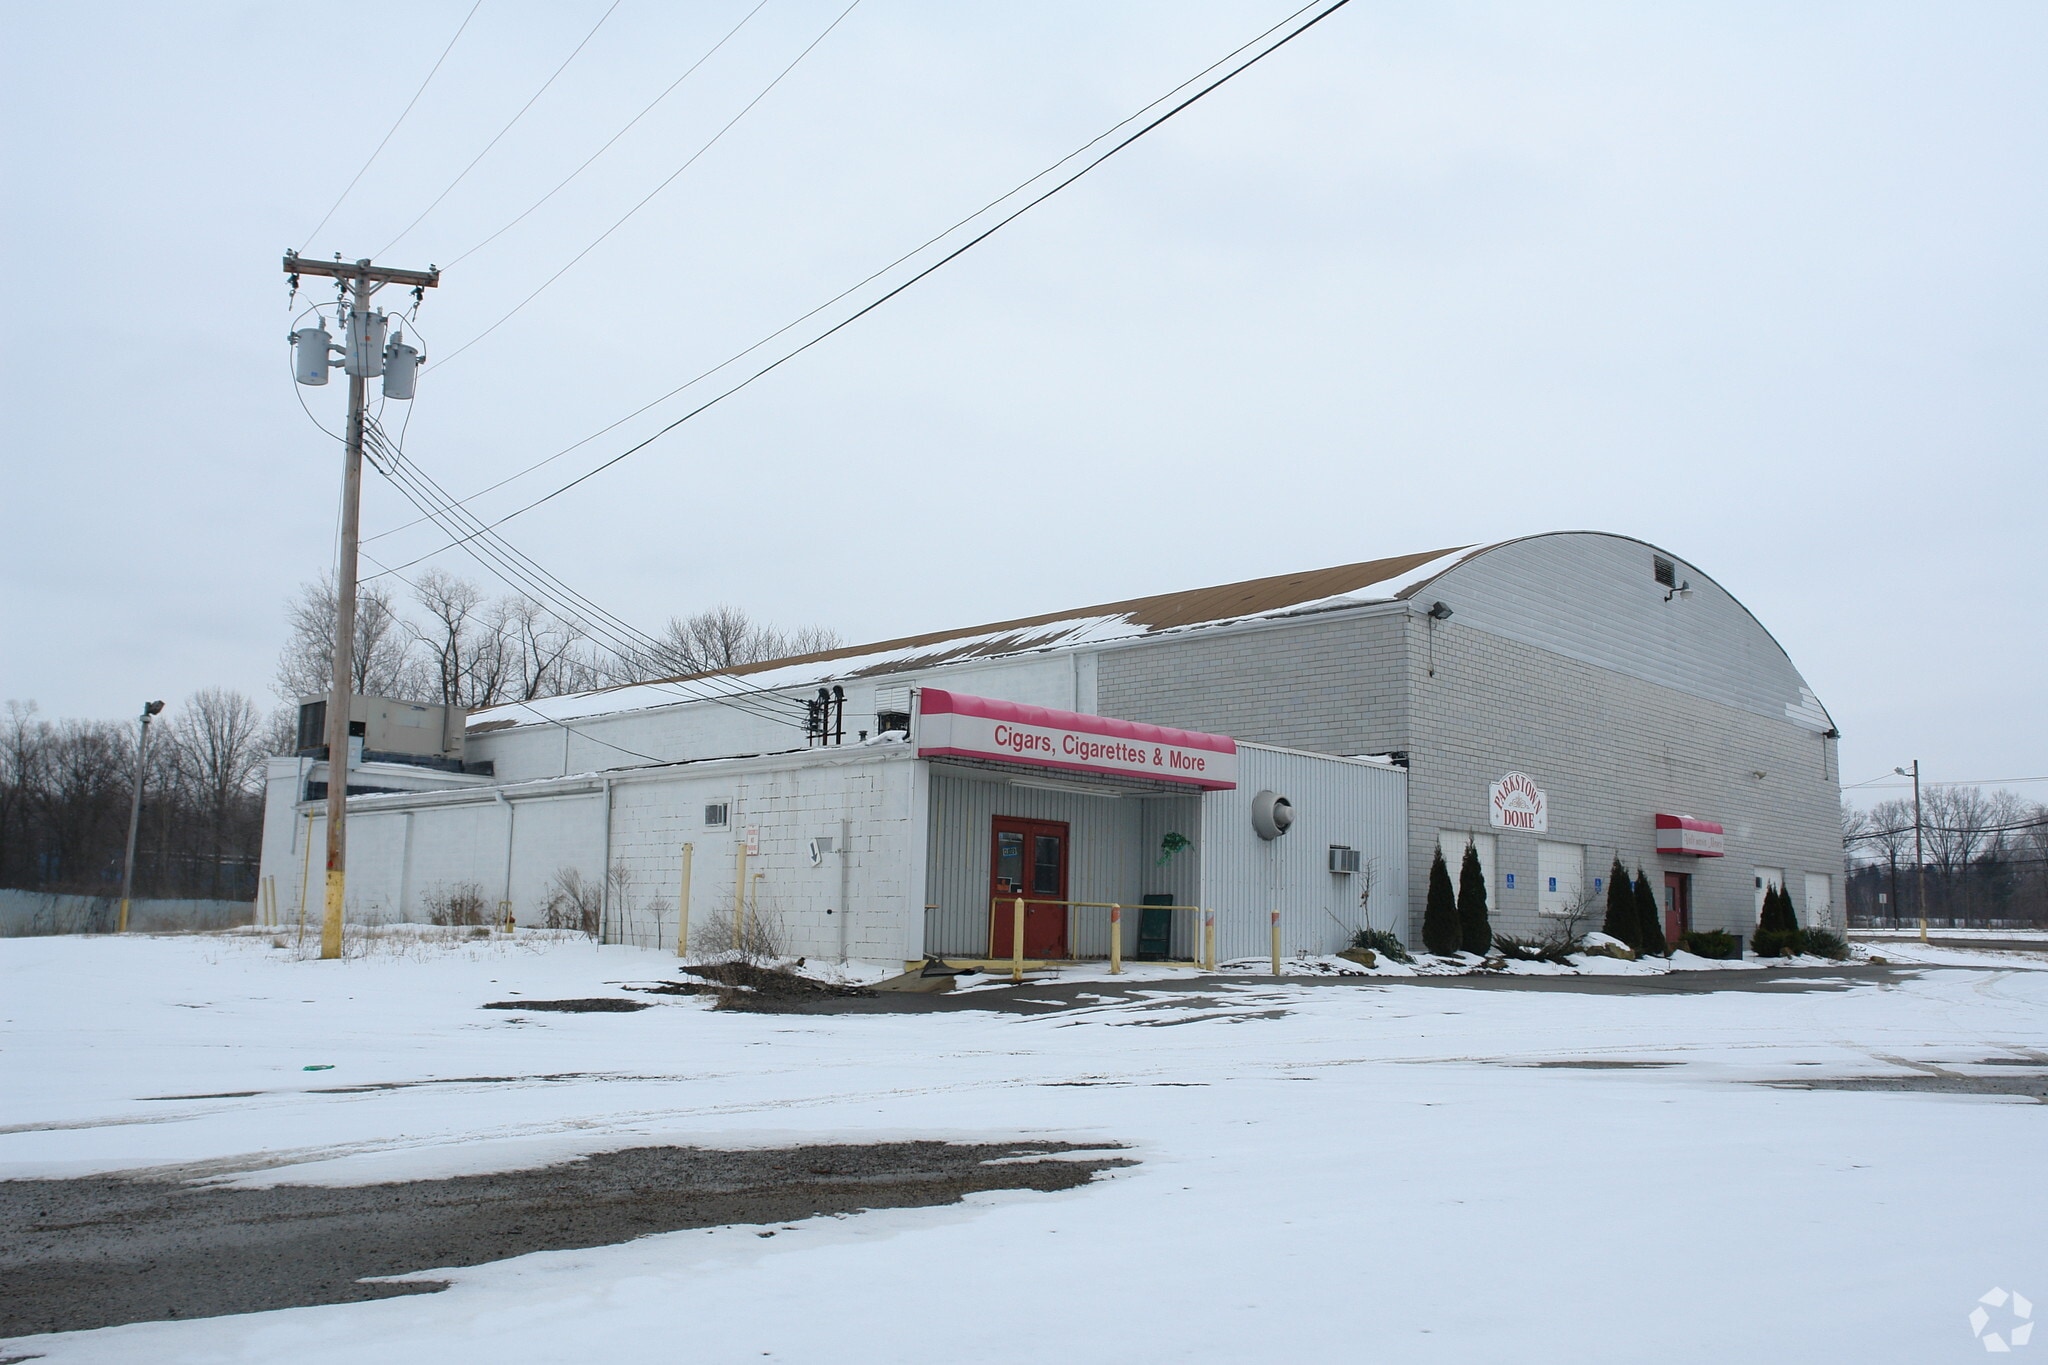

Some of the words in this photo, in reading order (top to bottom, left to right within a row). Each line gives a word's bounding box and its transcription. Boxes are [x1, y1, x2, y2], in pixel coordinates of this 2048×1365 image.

[994, 725, 1056, 756] Cigars,
[1062, 734, 1146, 762] Cigarettes
[1152, 747, 1163, 766] &
[1169, 750, 1206, 771] More
[1494, 774, 1543, 815] PARKSTOWN
[1503, 809, 1535, 829] DOME
